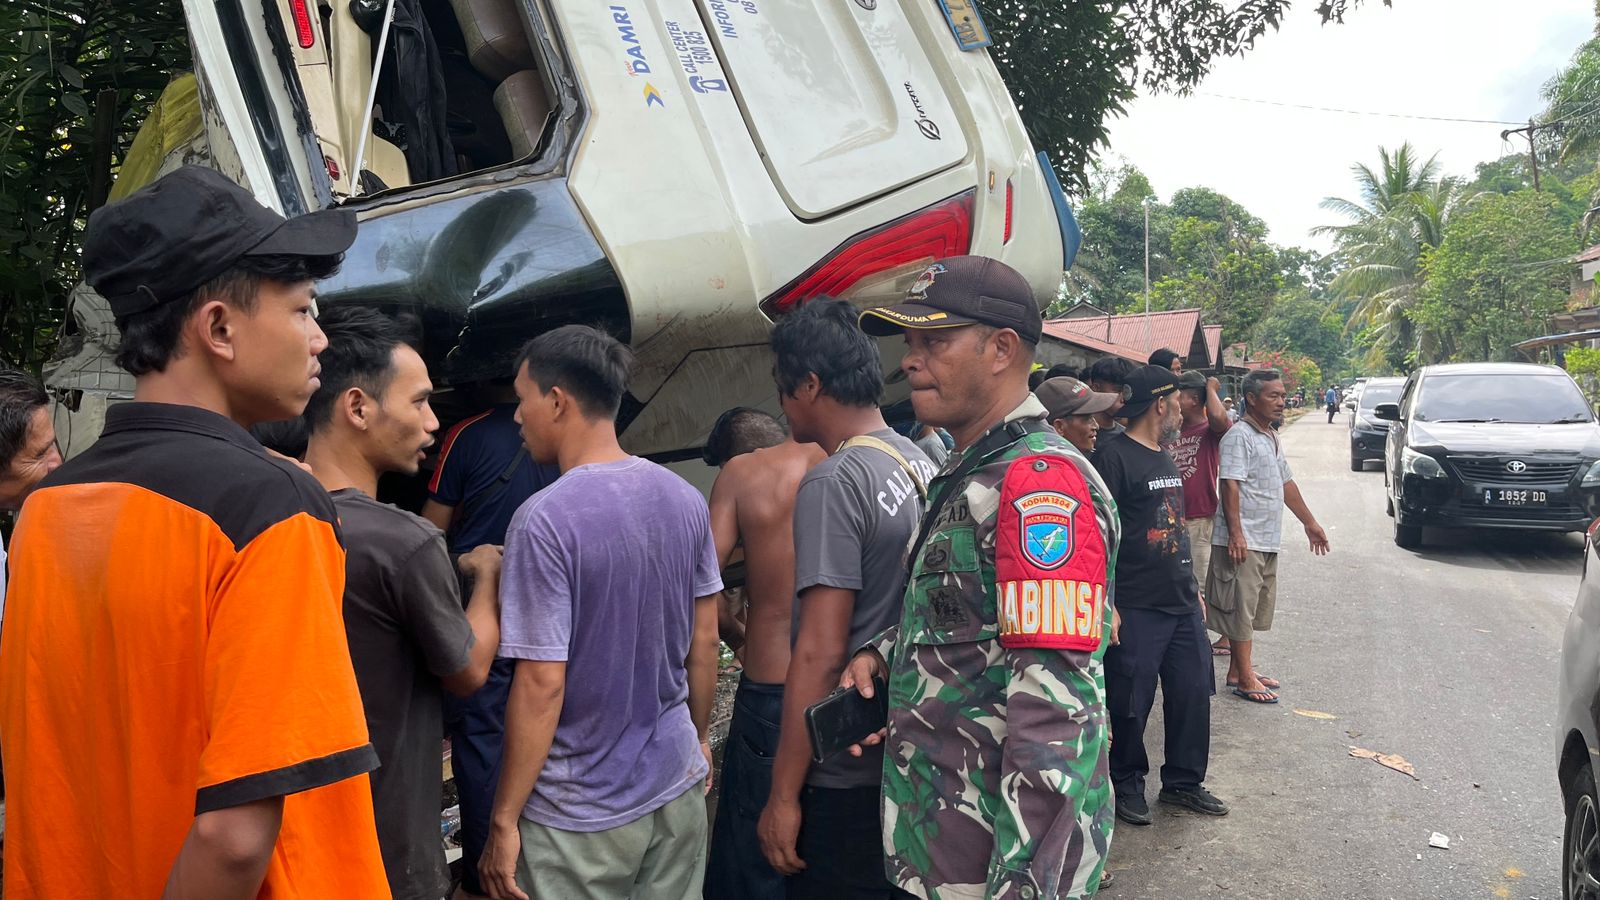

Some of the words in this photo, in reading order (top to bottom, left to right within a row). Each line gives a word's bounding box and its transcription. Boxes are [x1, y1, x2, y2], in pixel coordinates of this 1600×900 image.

[709, 0, 738, 39] INFOR
[608, 5, 651, 74] DAMRI
[665, 20, 689, 52] CENTER
[682, 30, 706, 45] 825
[679, 53, 698, 73] CALL
[689, 46, 714, 64] 1500
[1148, 479, 1165, 491] FIRE
[1021, 496, 1050, 509] KODIM
[1051, 497, 1070, 509] 1204
[1485, 490, 1491, 500] A
[1499, 490, 1527, 502] 1852
[1532, 491, 1546, 502] DD
